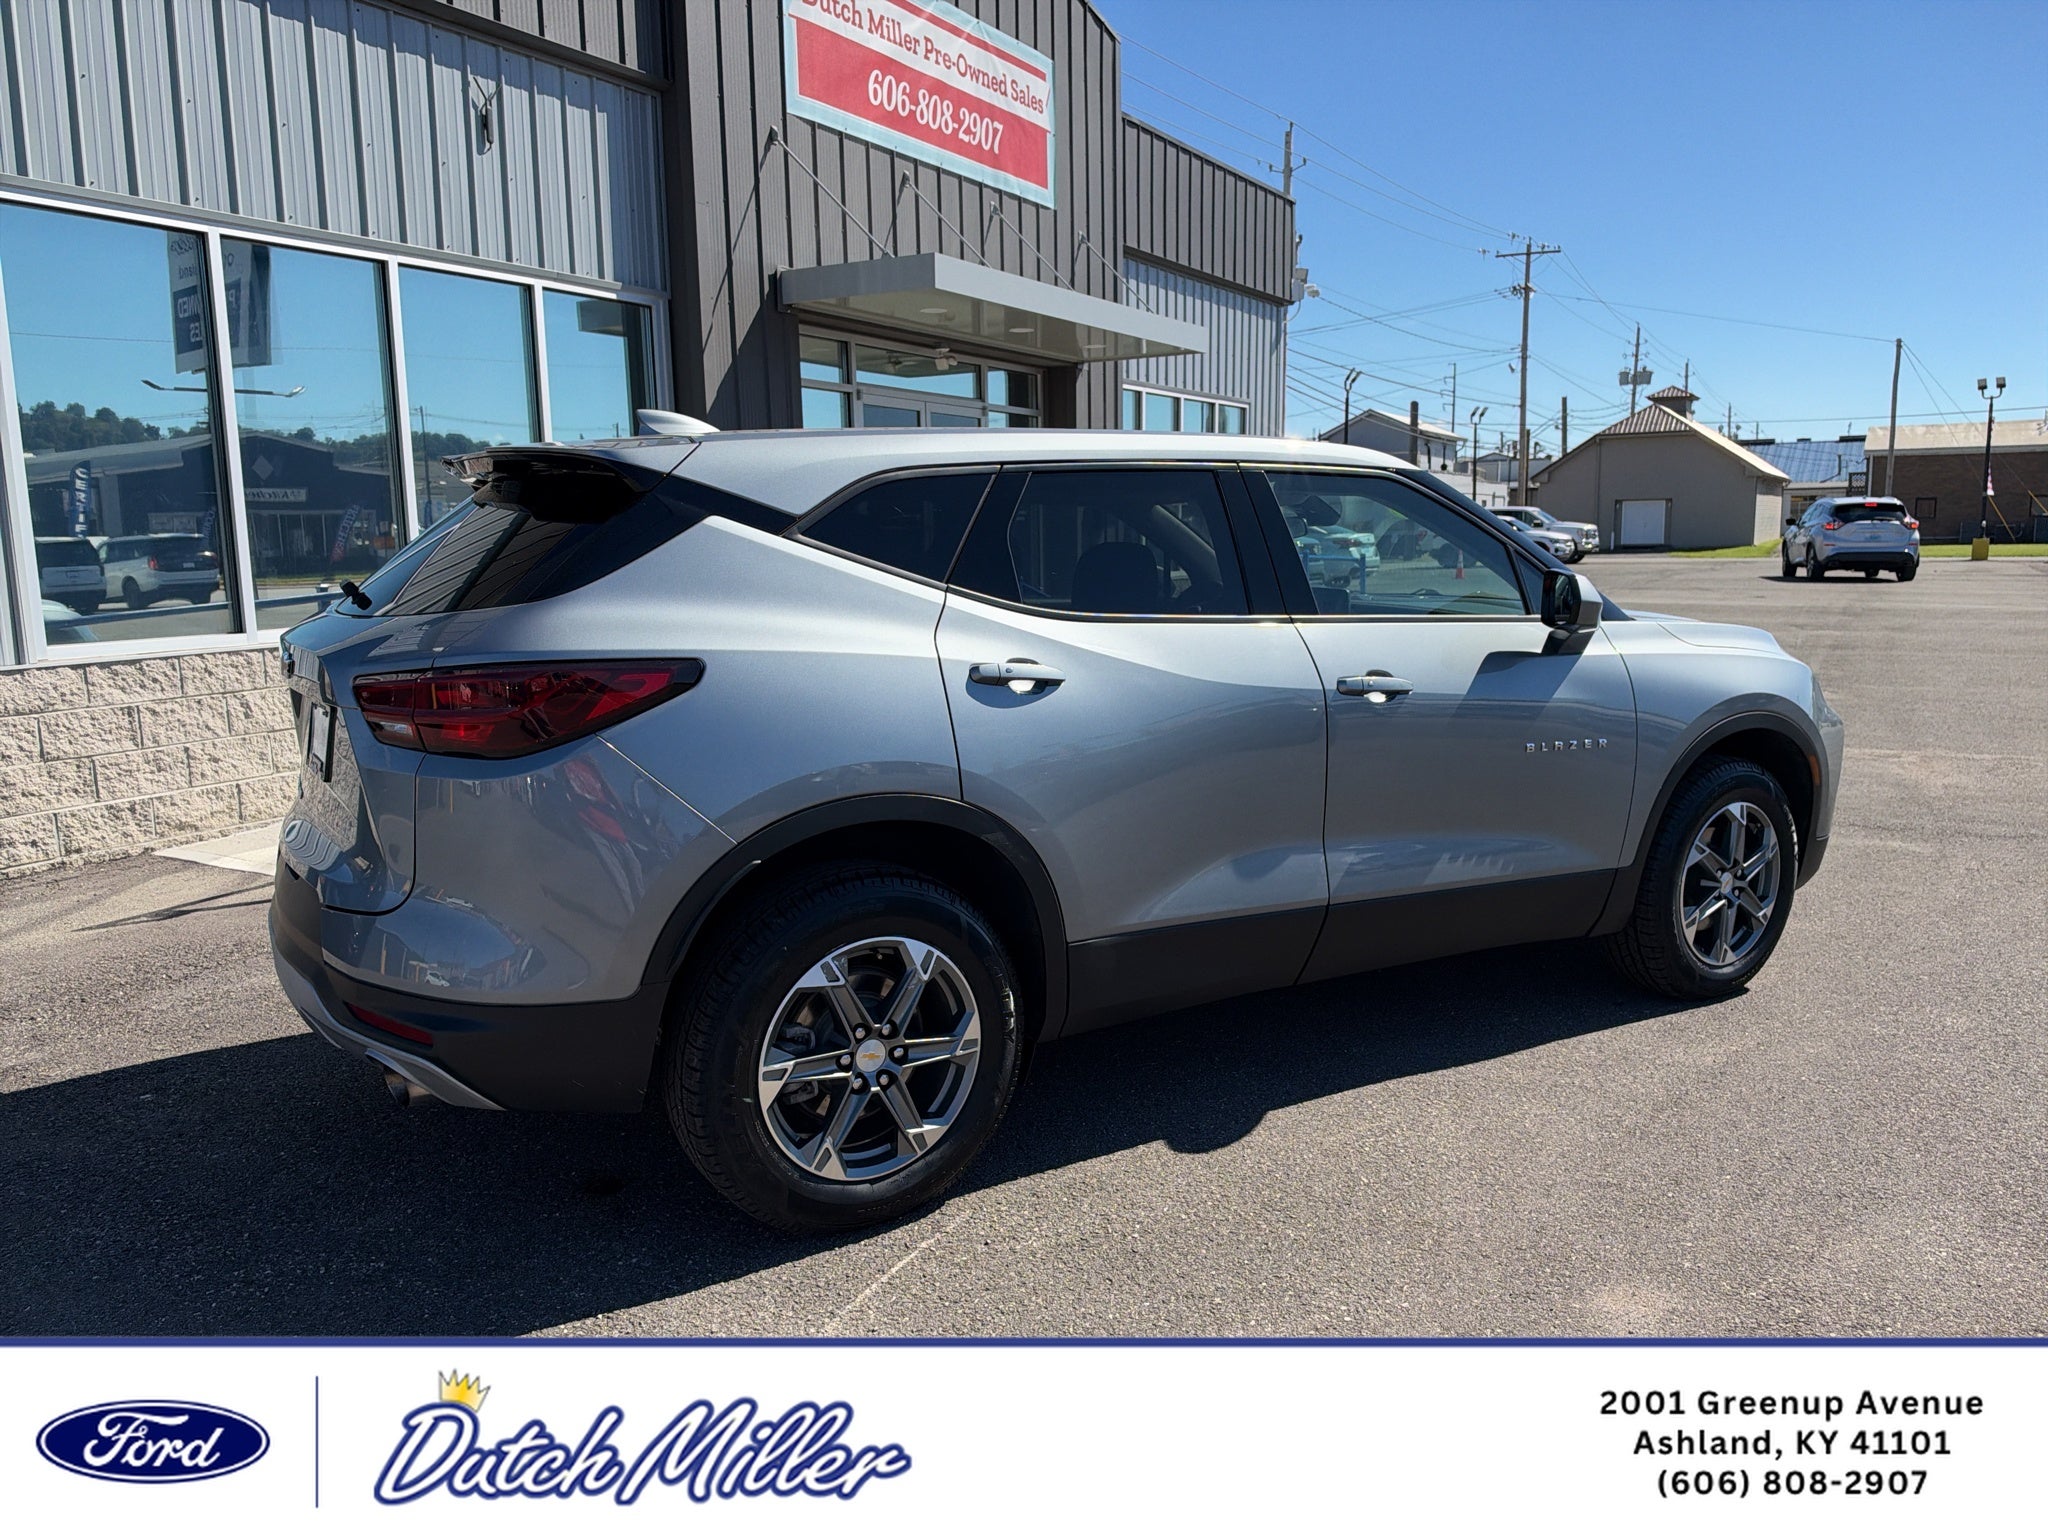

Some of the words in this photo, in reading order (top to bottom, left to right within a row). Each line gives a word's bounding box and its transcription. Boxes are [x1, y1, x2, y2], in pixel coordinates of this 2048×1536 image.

[802, 0, 864, 30] utch
[867, 7, 920, 56] Miller
[923, 35, 1009, 98] Pre-Owned
[1010, 78, 1045, 115] Sales
[867, 69, 1004, 155] 606-808-2907
[75, 467, 89, 539] CERTIF
[1525, 738, 1608, 753] BLAZER
